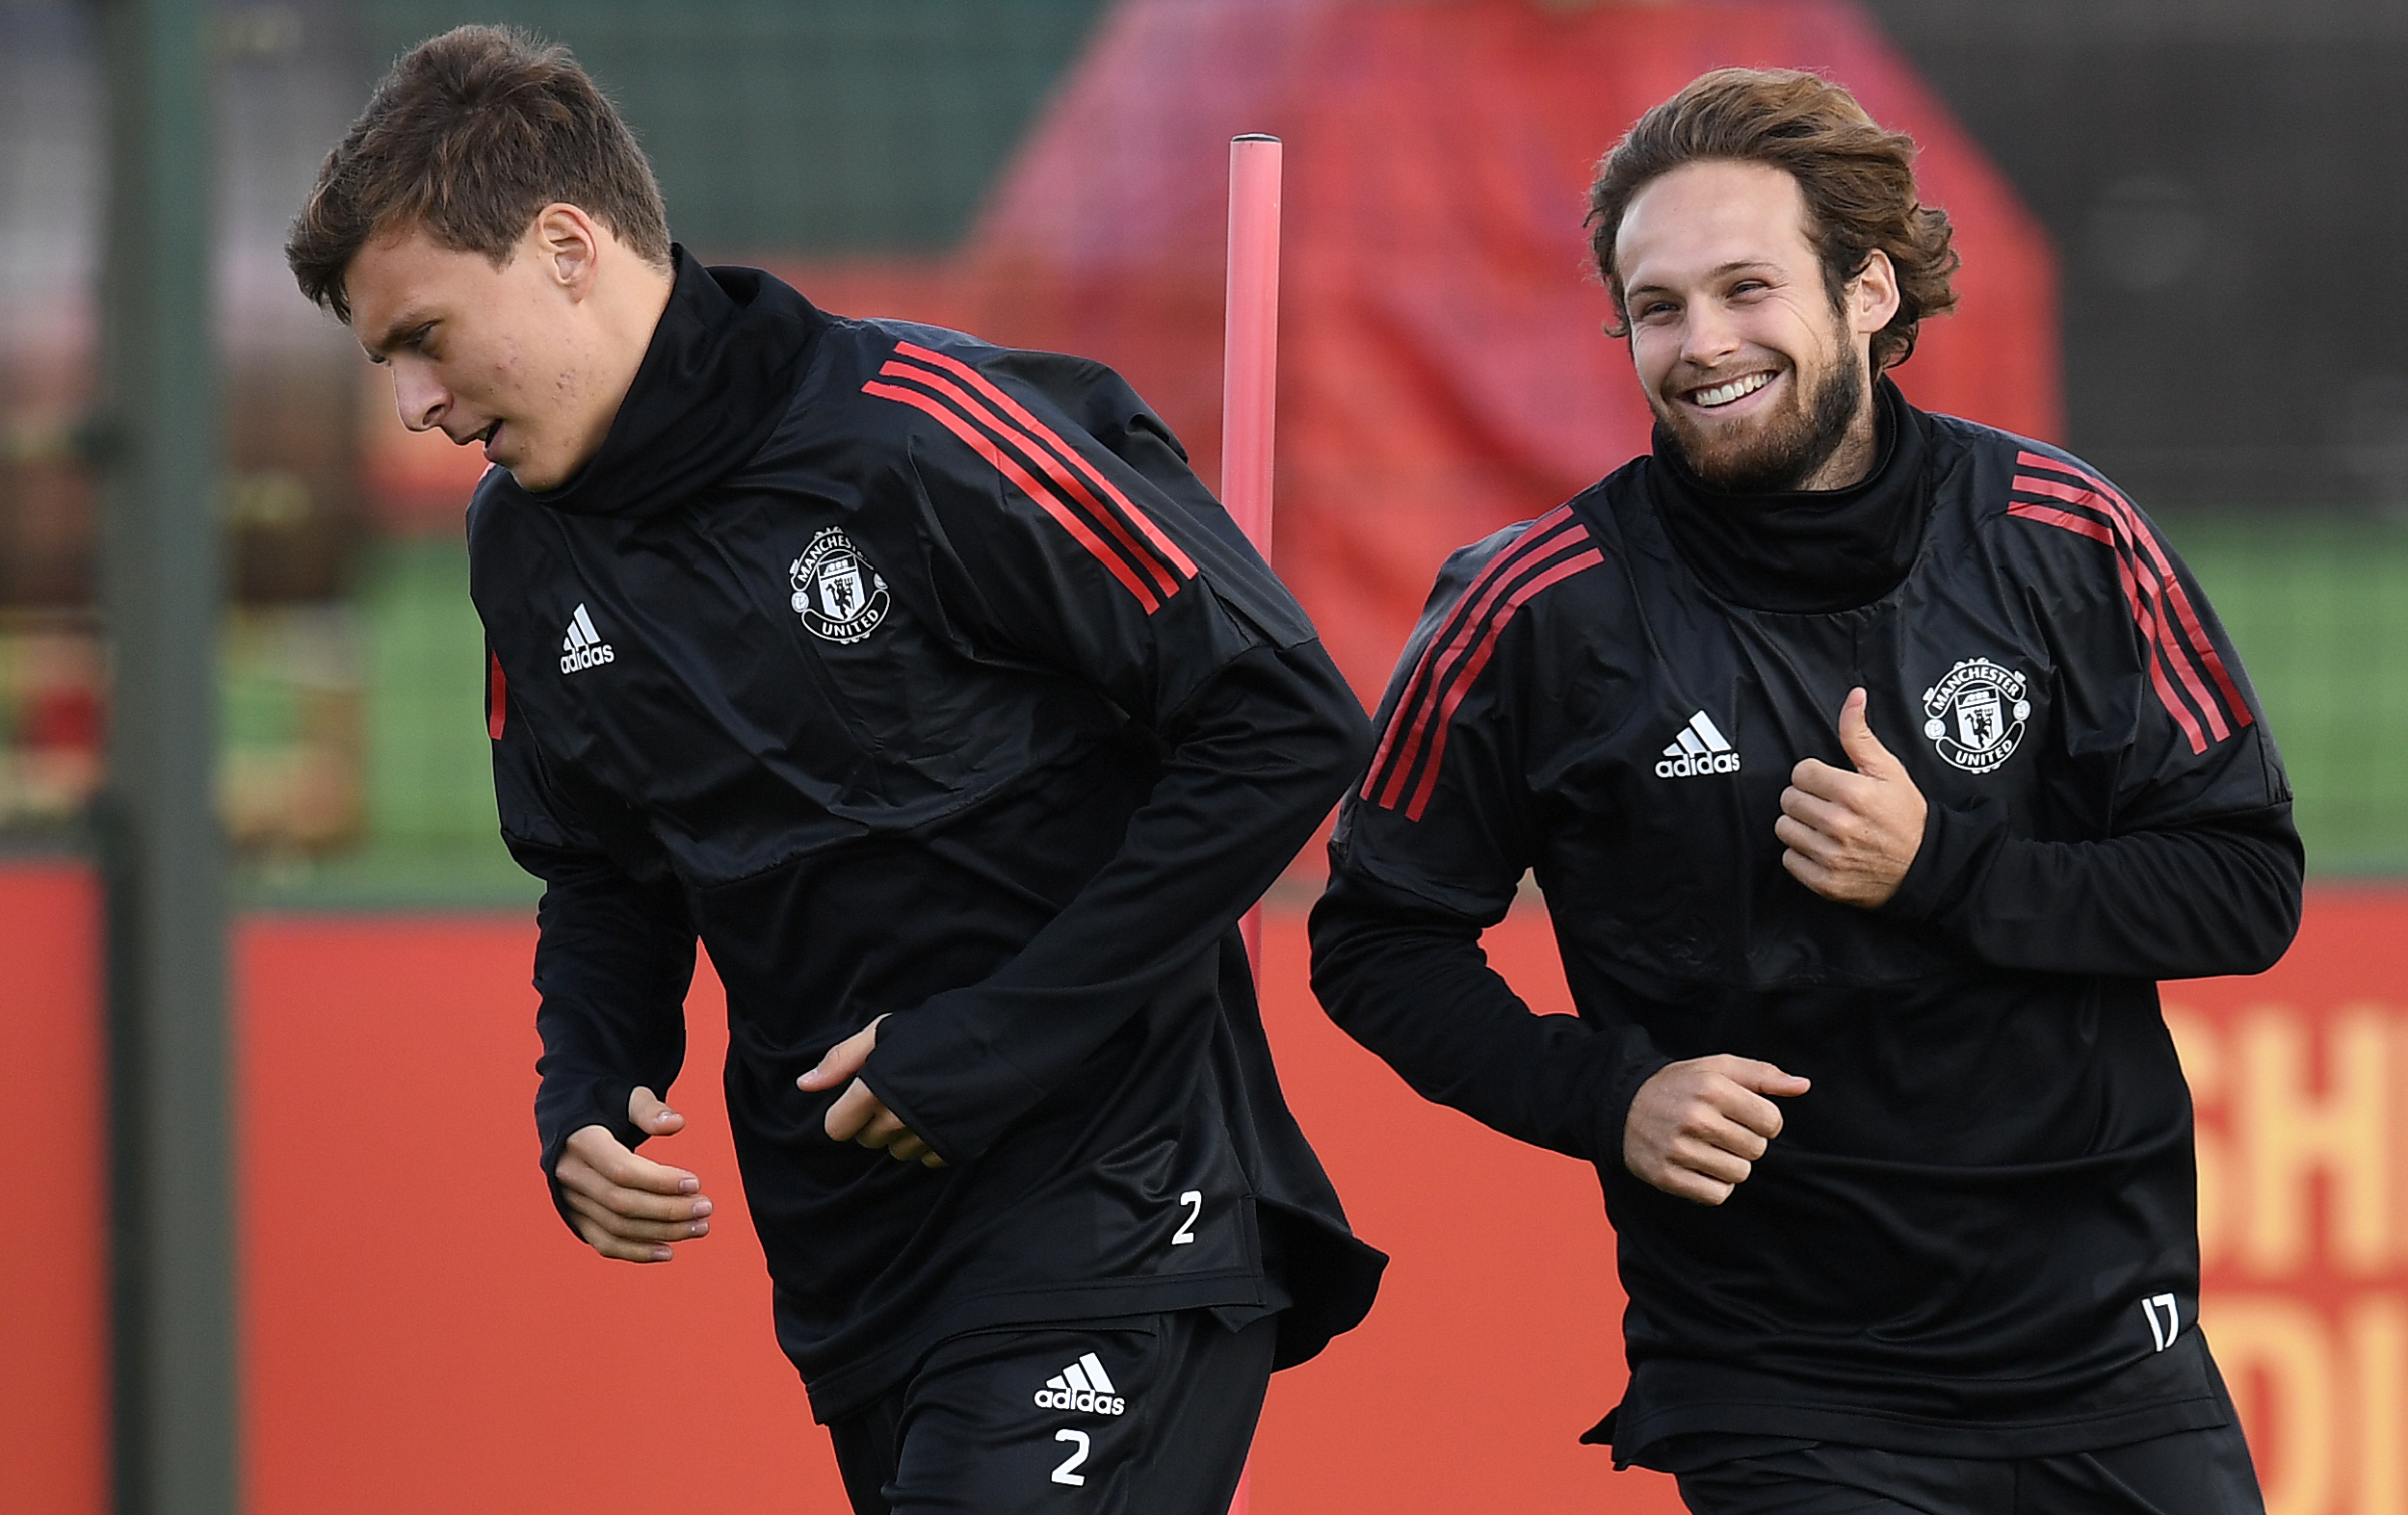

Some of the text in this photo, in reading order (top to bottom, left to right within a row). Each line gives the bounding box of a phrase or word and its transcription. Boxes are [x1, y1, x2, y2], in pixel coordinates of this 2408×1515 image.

[798, 535, 868, 583] MANCHES
[822, 609, 879, 637] UNITED
[560, 643, 615, 674] adidas
[1931, 666, 2020, 711] MANCHESTER
[1655, 751, 1741, 778] adidas
[1955, 739, 2013, 767] UNITED
[1171, 1189, 1202, 1245] 2
[2141, 1293, 2179, 1352] 17
[1034, 1387, 1126, 1416] adidas
[1051, 1428, 1090, 1486] 2
